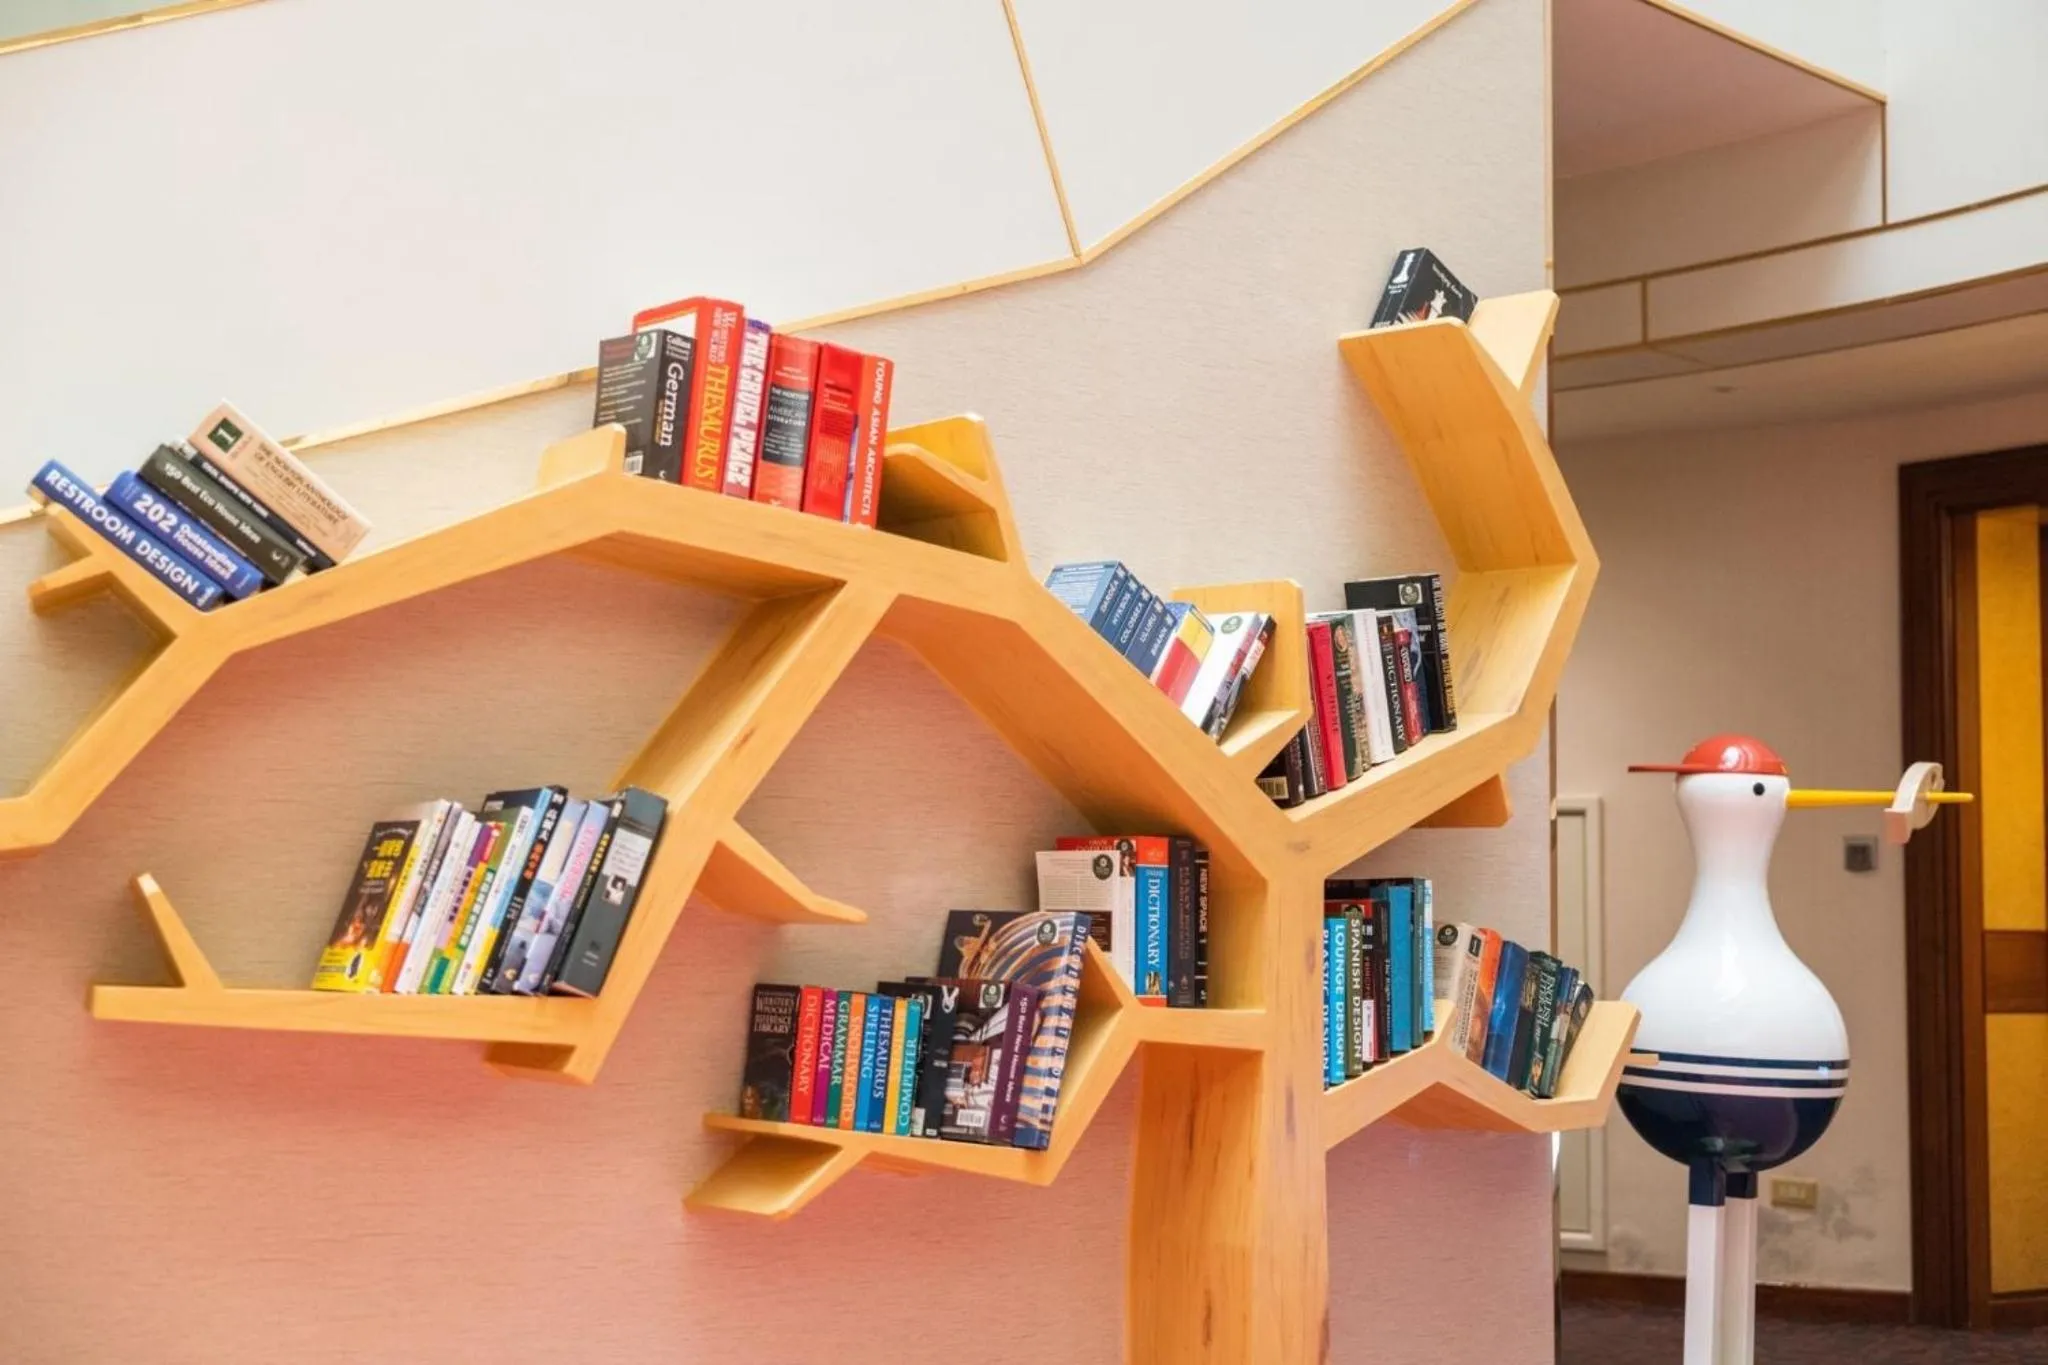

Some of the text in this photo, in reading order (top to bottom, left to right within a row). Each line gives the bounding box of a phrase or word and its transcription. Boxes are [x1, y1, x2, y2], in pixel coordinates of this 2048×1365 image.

[657, 362, 685, 447] German
[692, 362, 730, 479] THESAURUS
[724, 331, 769, 487] THE CRUEL PEACE
[858, 359, 887, 516] YOUNG ASIAN ARCHITECTS
[42, 467, 201, 595] RESTROOM DESIGN
[132, 491, 179, 533] 202
[160, 462, 182, 483] 150
[179, 475, 202, 495] Best
[197, 489, 216, 507] Eco
[212, 502, 241, 527] House
[1382, 654, 1406, 741] DICTIONARY
[1145, 878, 1160, 966] DICTIONARY
[1198, 896, 1207, 932] SPACE
[1199, 868, 1207, 893] NEW
[1335, 924, 1345, 994] LOUNGE
[1350, 918, 1361, 989] SPANISH
[797, 995, 817, 1094] DICTIONARY
[818, 998, 834, 1072] MEDICAL
[830, 1000, 849, 1085] GRAMMAR
[861, 1003, 878, 1079] SPELLING
[873, 1006, 892, 1099] THESAURUS
[1016, 1014, 1025, 1032] Best
[1336, 1001, 1344, 1064] DESIGN
[1352, 996, 1361, 1057] DESIGN
[841, 1014, 861, 1121] QUOTATIONS
[898, 1038, 916, 1126] COMPUTER
